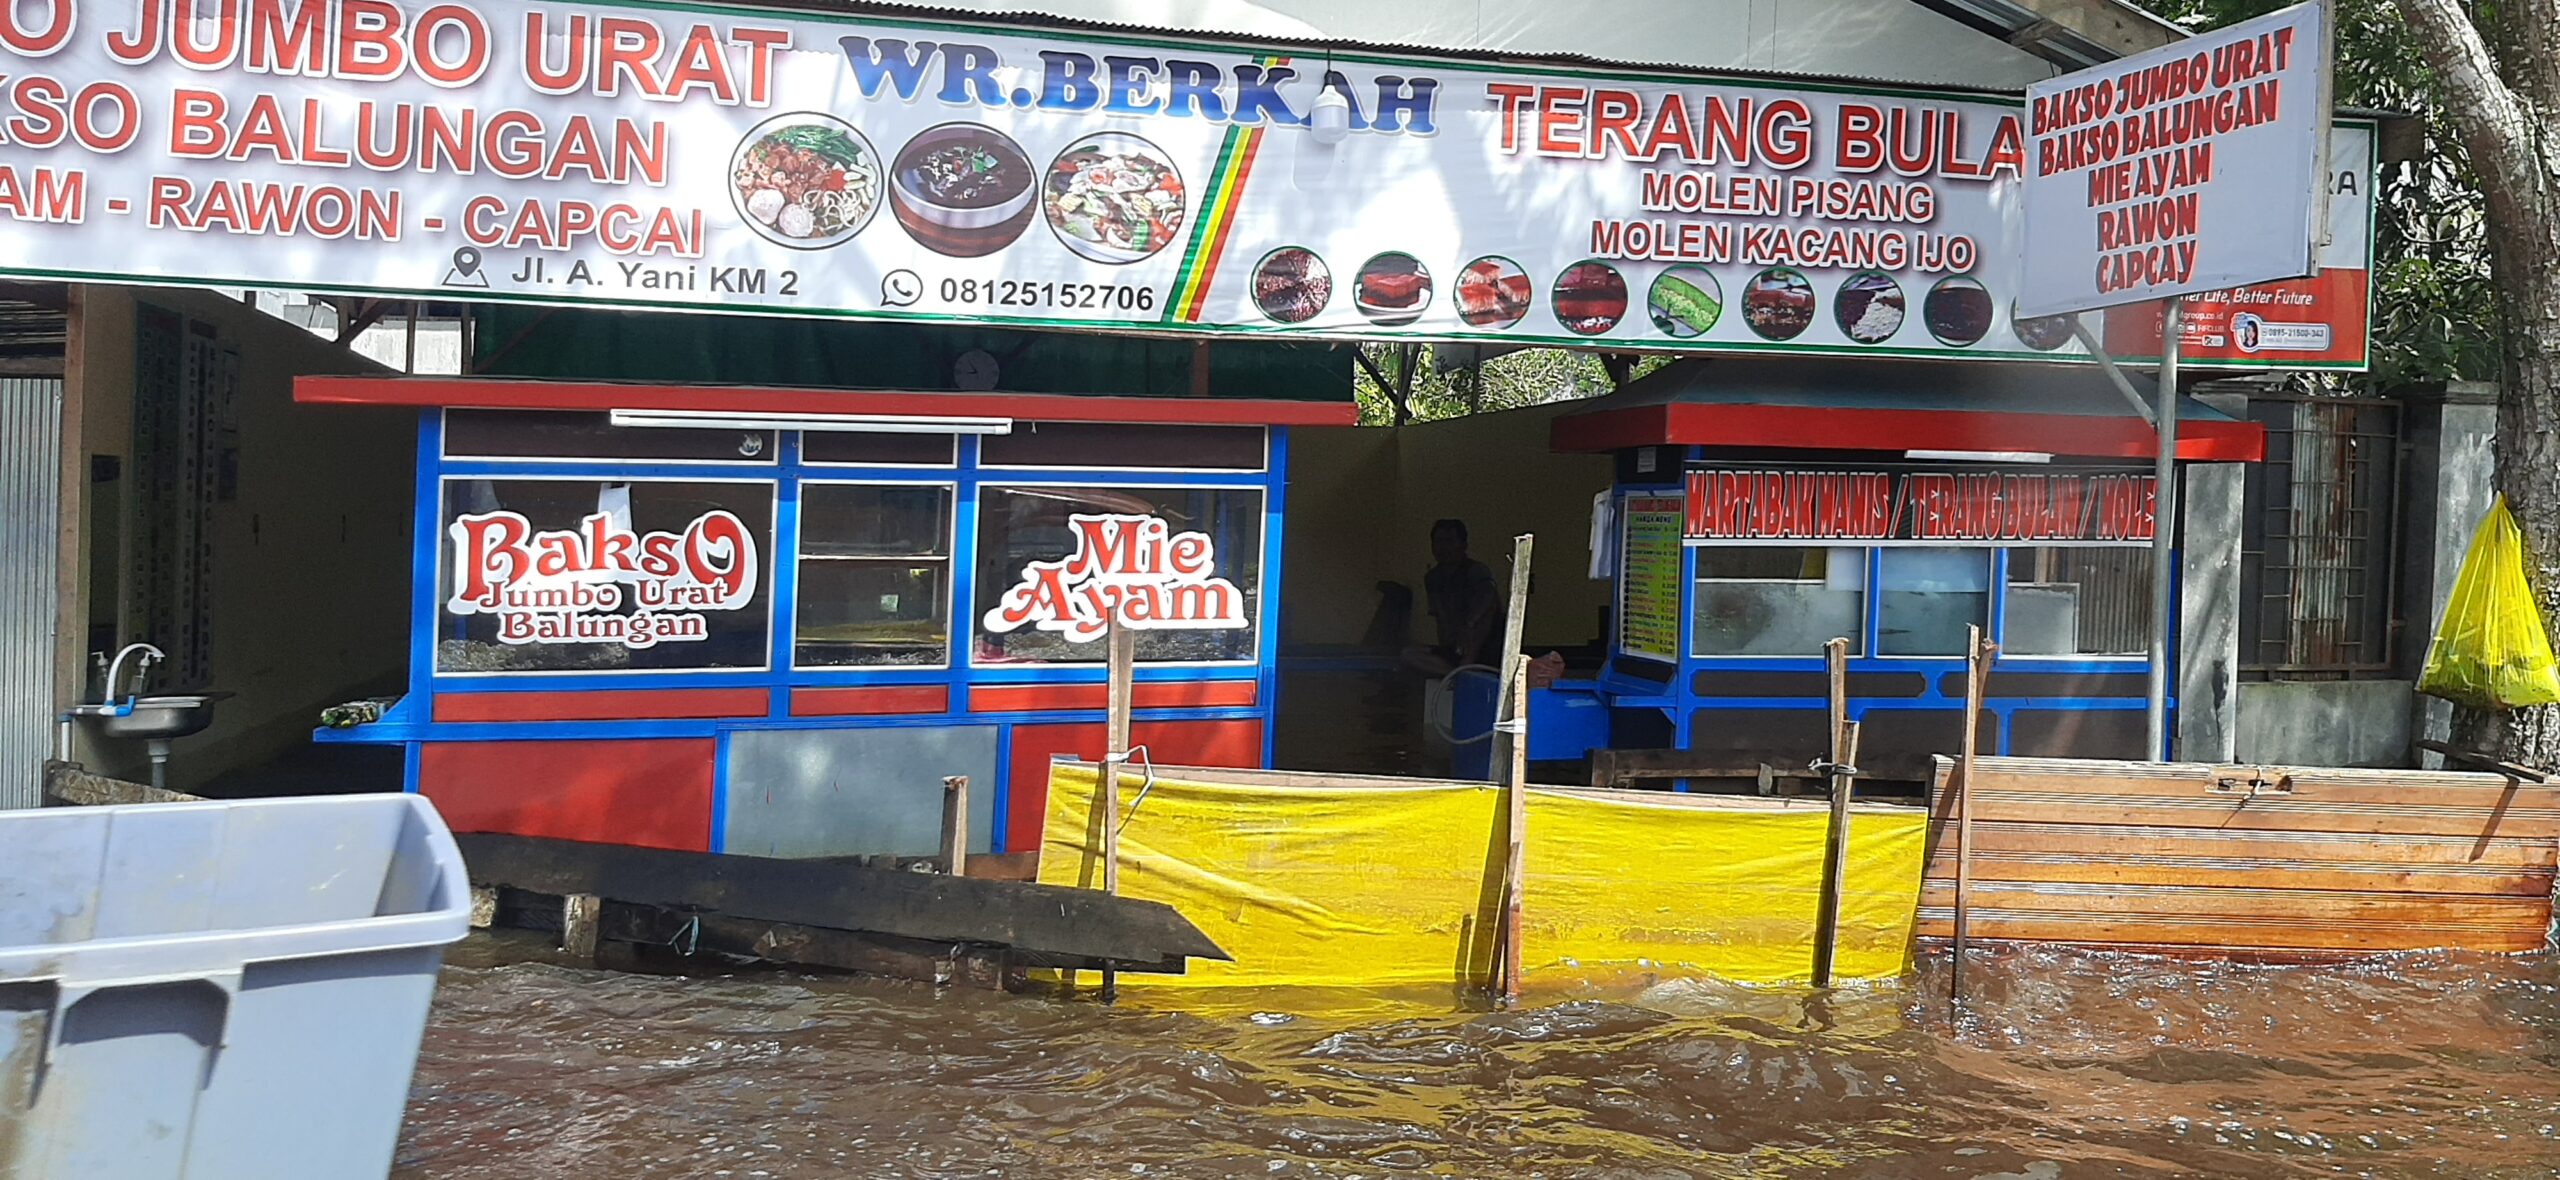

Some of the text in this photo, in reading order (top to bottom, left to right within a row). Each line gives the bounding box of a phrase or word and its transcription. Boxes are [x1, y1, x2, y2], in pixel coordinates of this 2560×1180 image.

[106, 0, 488, 83] JUMBO
[526, 10, 790, 104] URAT
[2031, 26, 2295, 137] BAKSO JUMBO URAT
[837, 36, 1440, 134] WR.BERKAH
[170, 89, 667, 185] BALUNGAN
[1486, 82, 1812, 169] TERANG
[2038, 78, 2280, 177] BAKSO BALUNGAN
[1642, 172, 1933, 222] MOLEN PISANG
[2087, 142, 2212, 208] MIE AYAM
[149, 177, 400, 239] RAWON
[462, 196, 704, 257] CAPCAI
[1591, 221, 1976, 272] MOLEN KACANG IJO
[2096, 192, 2198, 253] RAWON
[511, 256, 799, 296] Jl. A. Yani KM 2
[939, 275, 1155, 312] 08125152706
[2095, 240, 2198, 295] CAPCAY
[2233, 288, 2271, 304] Better
[2274, 289, 2313, 305] Future
[1684, 470, 1815, 539] MARTABAK
[1814, 471, 1889, 538] MANIS
[1910, 471, 2002, 541] TERANG
[2002, 473, 2081, 541] BULAN
[1066, 519, 1205, 576] Mie
[480, 578, 727, 608] Jumbo Urat
[1001, 567, 1232, 634] Ayam
[501, 612, 702, 643] Balungan
